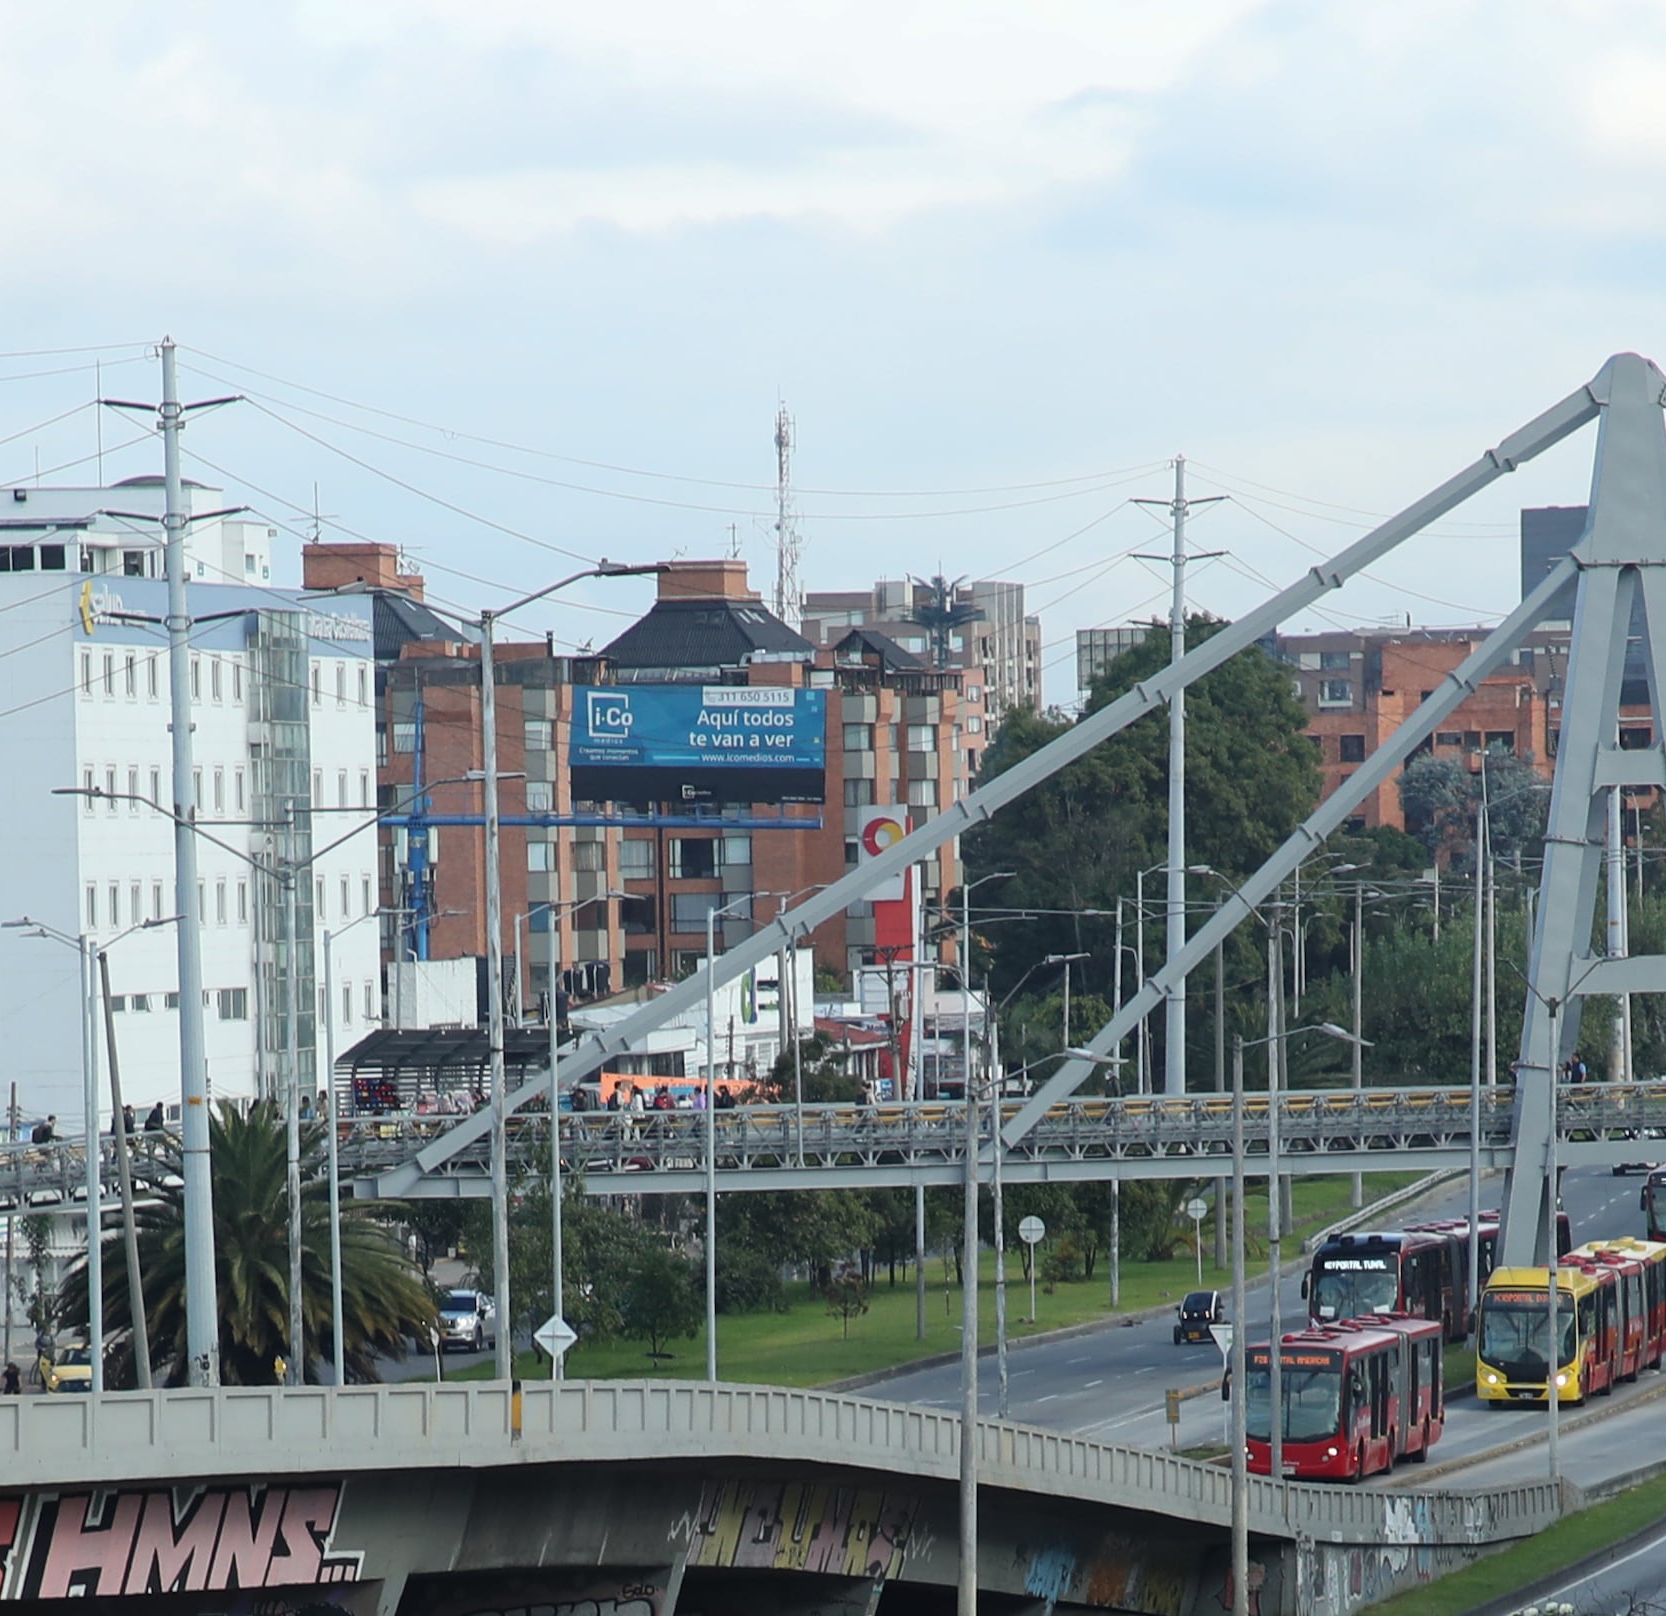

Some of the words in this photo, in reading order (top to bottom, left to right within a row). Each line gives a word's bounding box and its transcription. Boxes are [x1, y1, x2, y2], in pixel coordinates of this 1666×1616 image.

[717, 693, 738, 703] 311
[740, 693, 761, 703] 650
[763, 693, 790, 703] 5115
[696, 708, 740, 730] Aquí
[743, 709, 795, 727] todos
[689, 731, 710, 747] te
[711, 734, 746, 747] van
[749, 735, 761, 747] a
[764, 734, 794, 748] ver
[700, 752, 795, 763] www.icomedios.com
